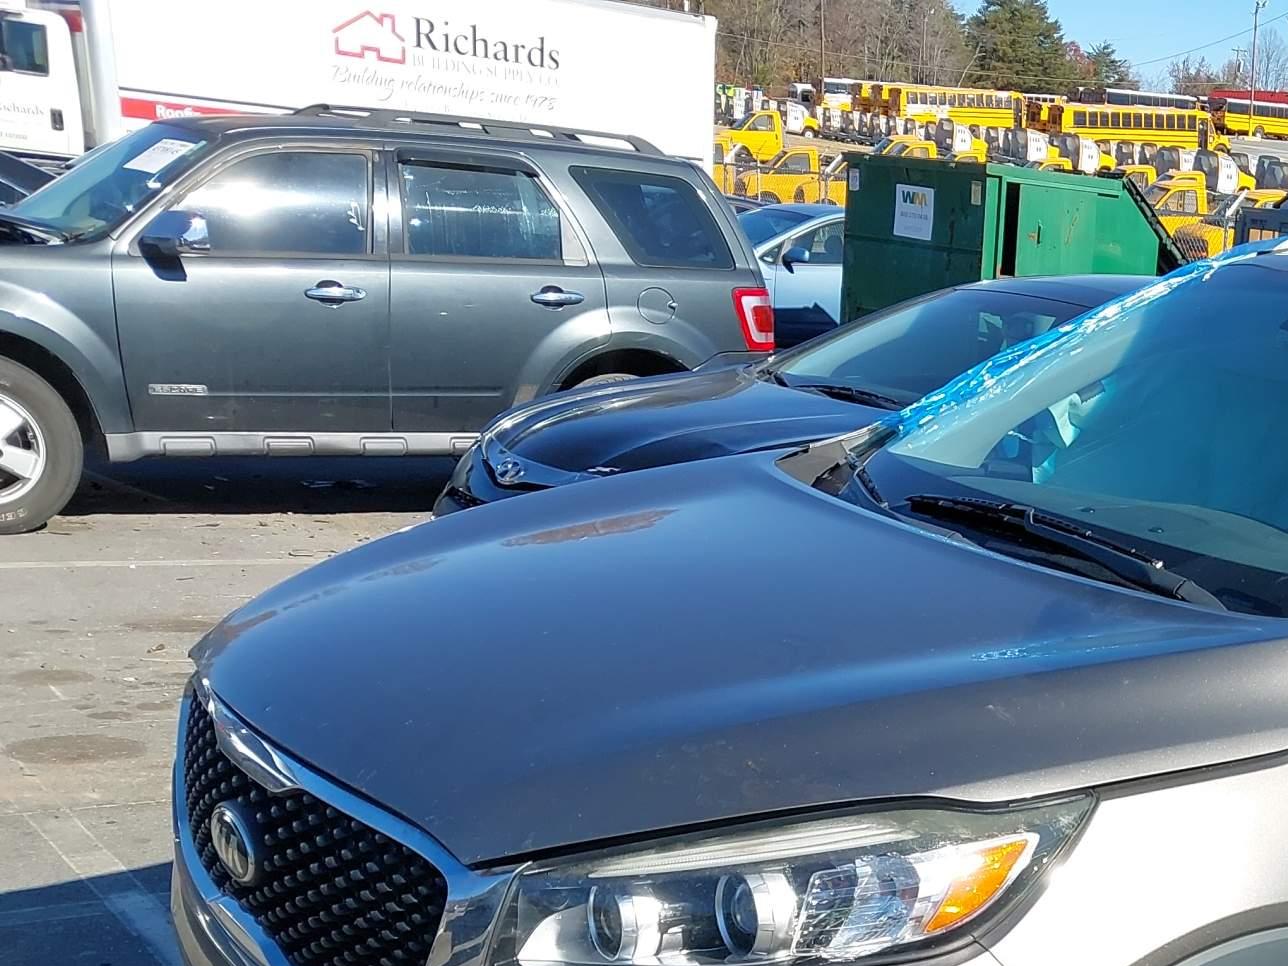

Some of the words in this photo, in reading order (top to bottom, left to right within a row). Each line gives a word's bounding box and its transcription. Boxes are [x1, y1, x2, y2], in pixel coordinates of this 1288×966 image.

[412, 16, 561, 71] Richards
[332, 64, 395, 102] Building
[400, 73, 486, 105] relationships
[489, 89, 523, 107] since
[901, 190, 928, 206] WM
